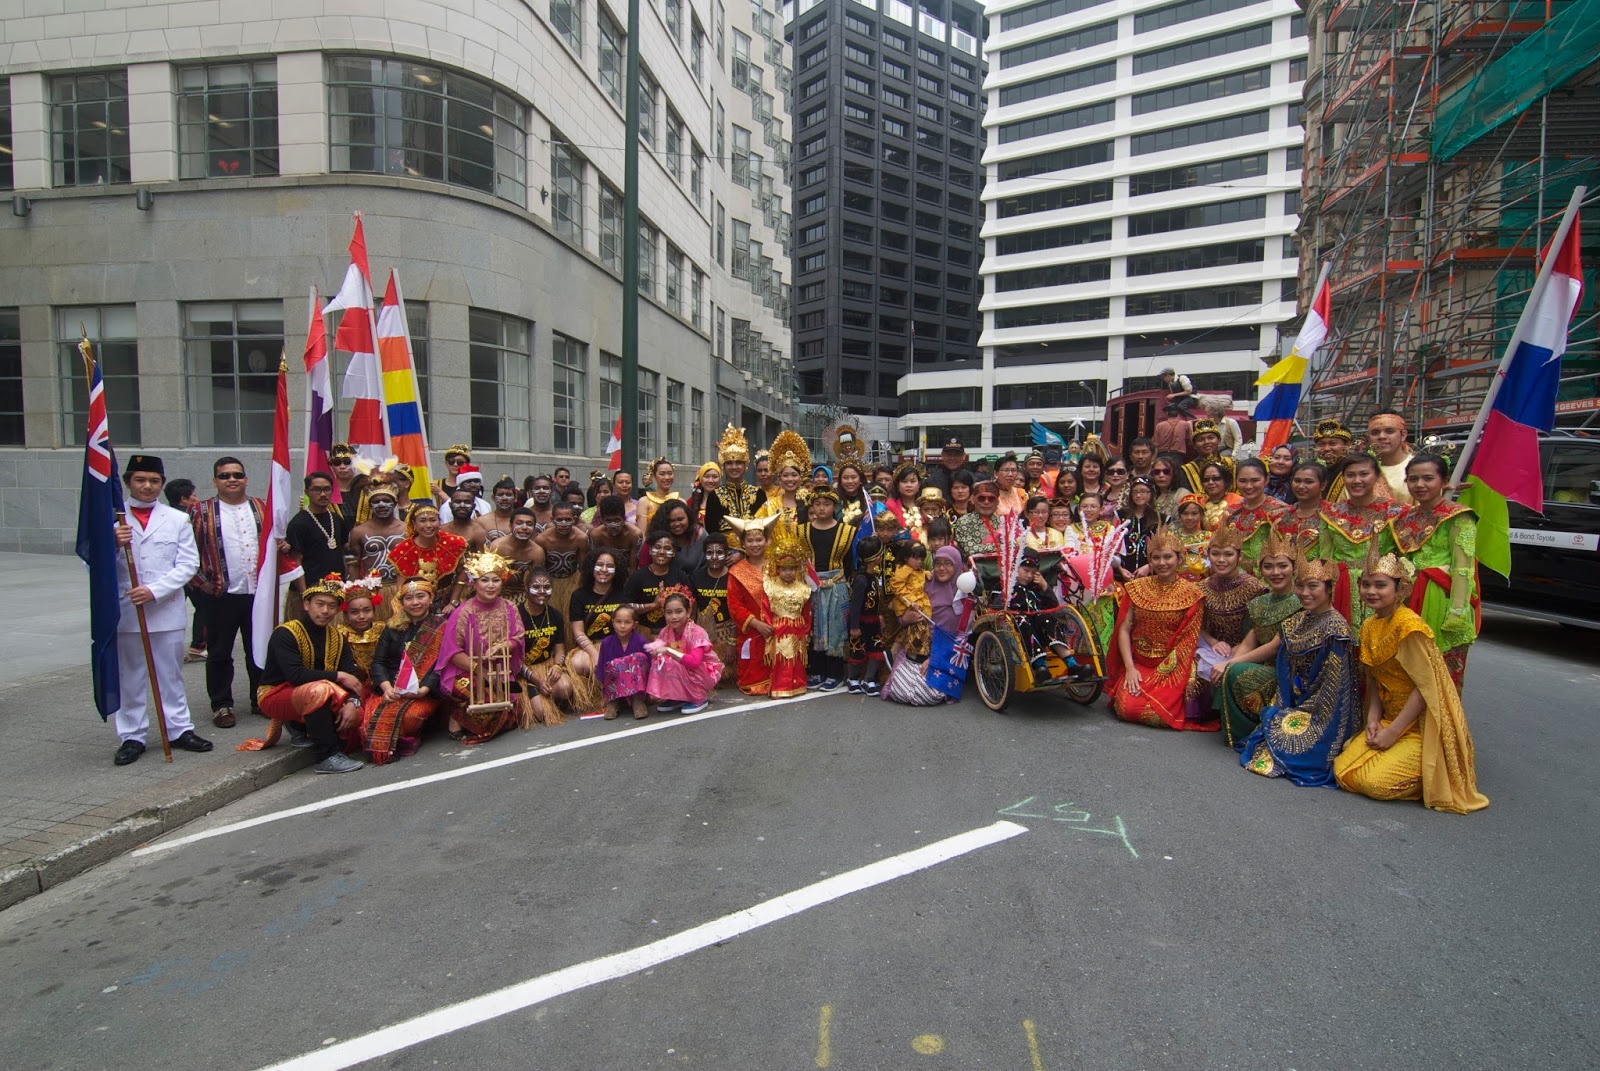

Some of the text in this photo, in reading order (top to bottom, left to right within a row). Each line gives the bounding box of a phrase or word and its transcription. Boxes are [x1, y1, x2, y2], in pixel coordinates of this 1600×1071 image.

[1560, 400, 1594, 411] GEEVES
[1452, 415, 1468, 424] 0800
[1519, 532, 1535, 540] Bond
[1536, 534, 1556, 542] Toyota
